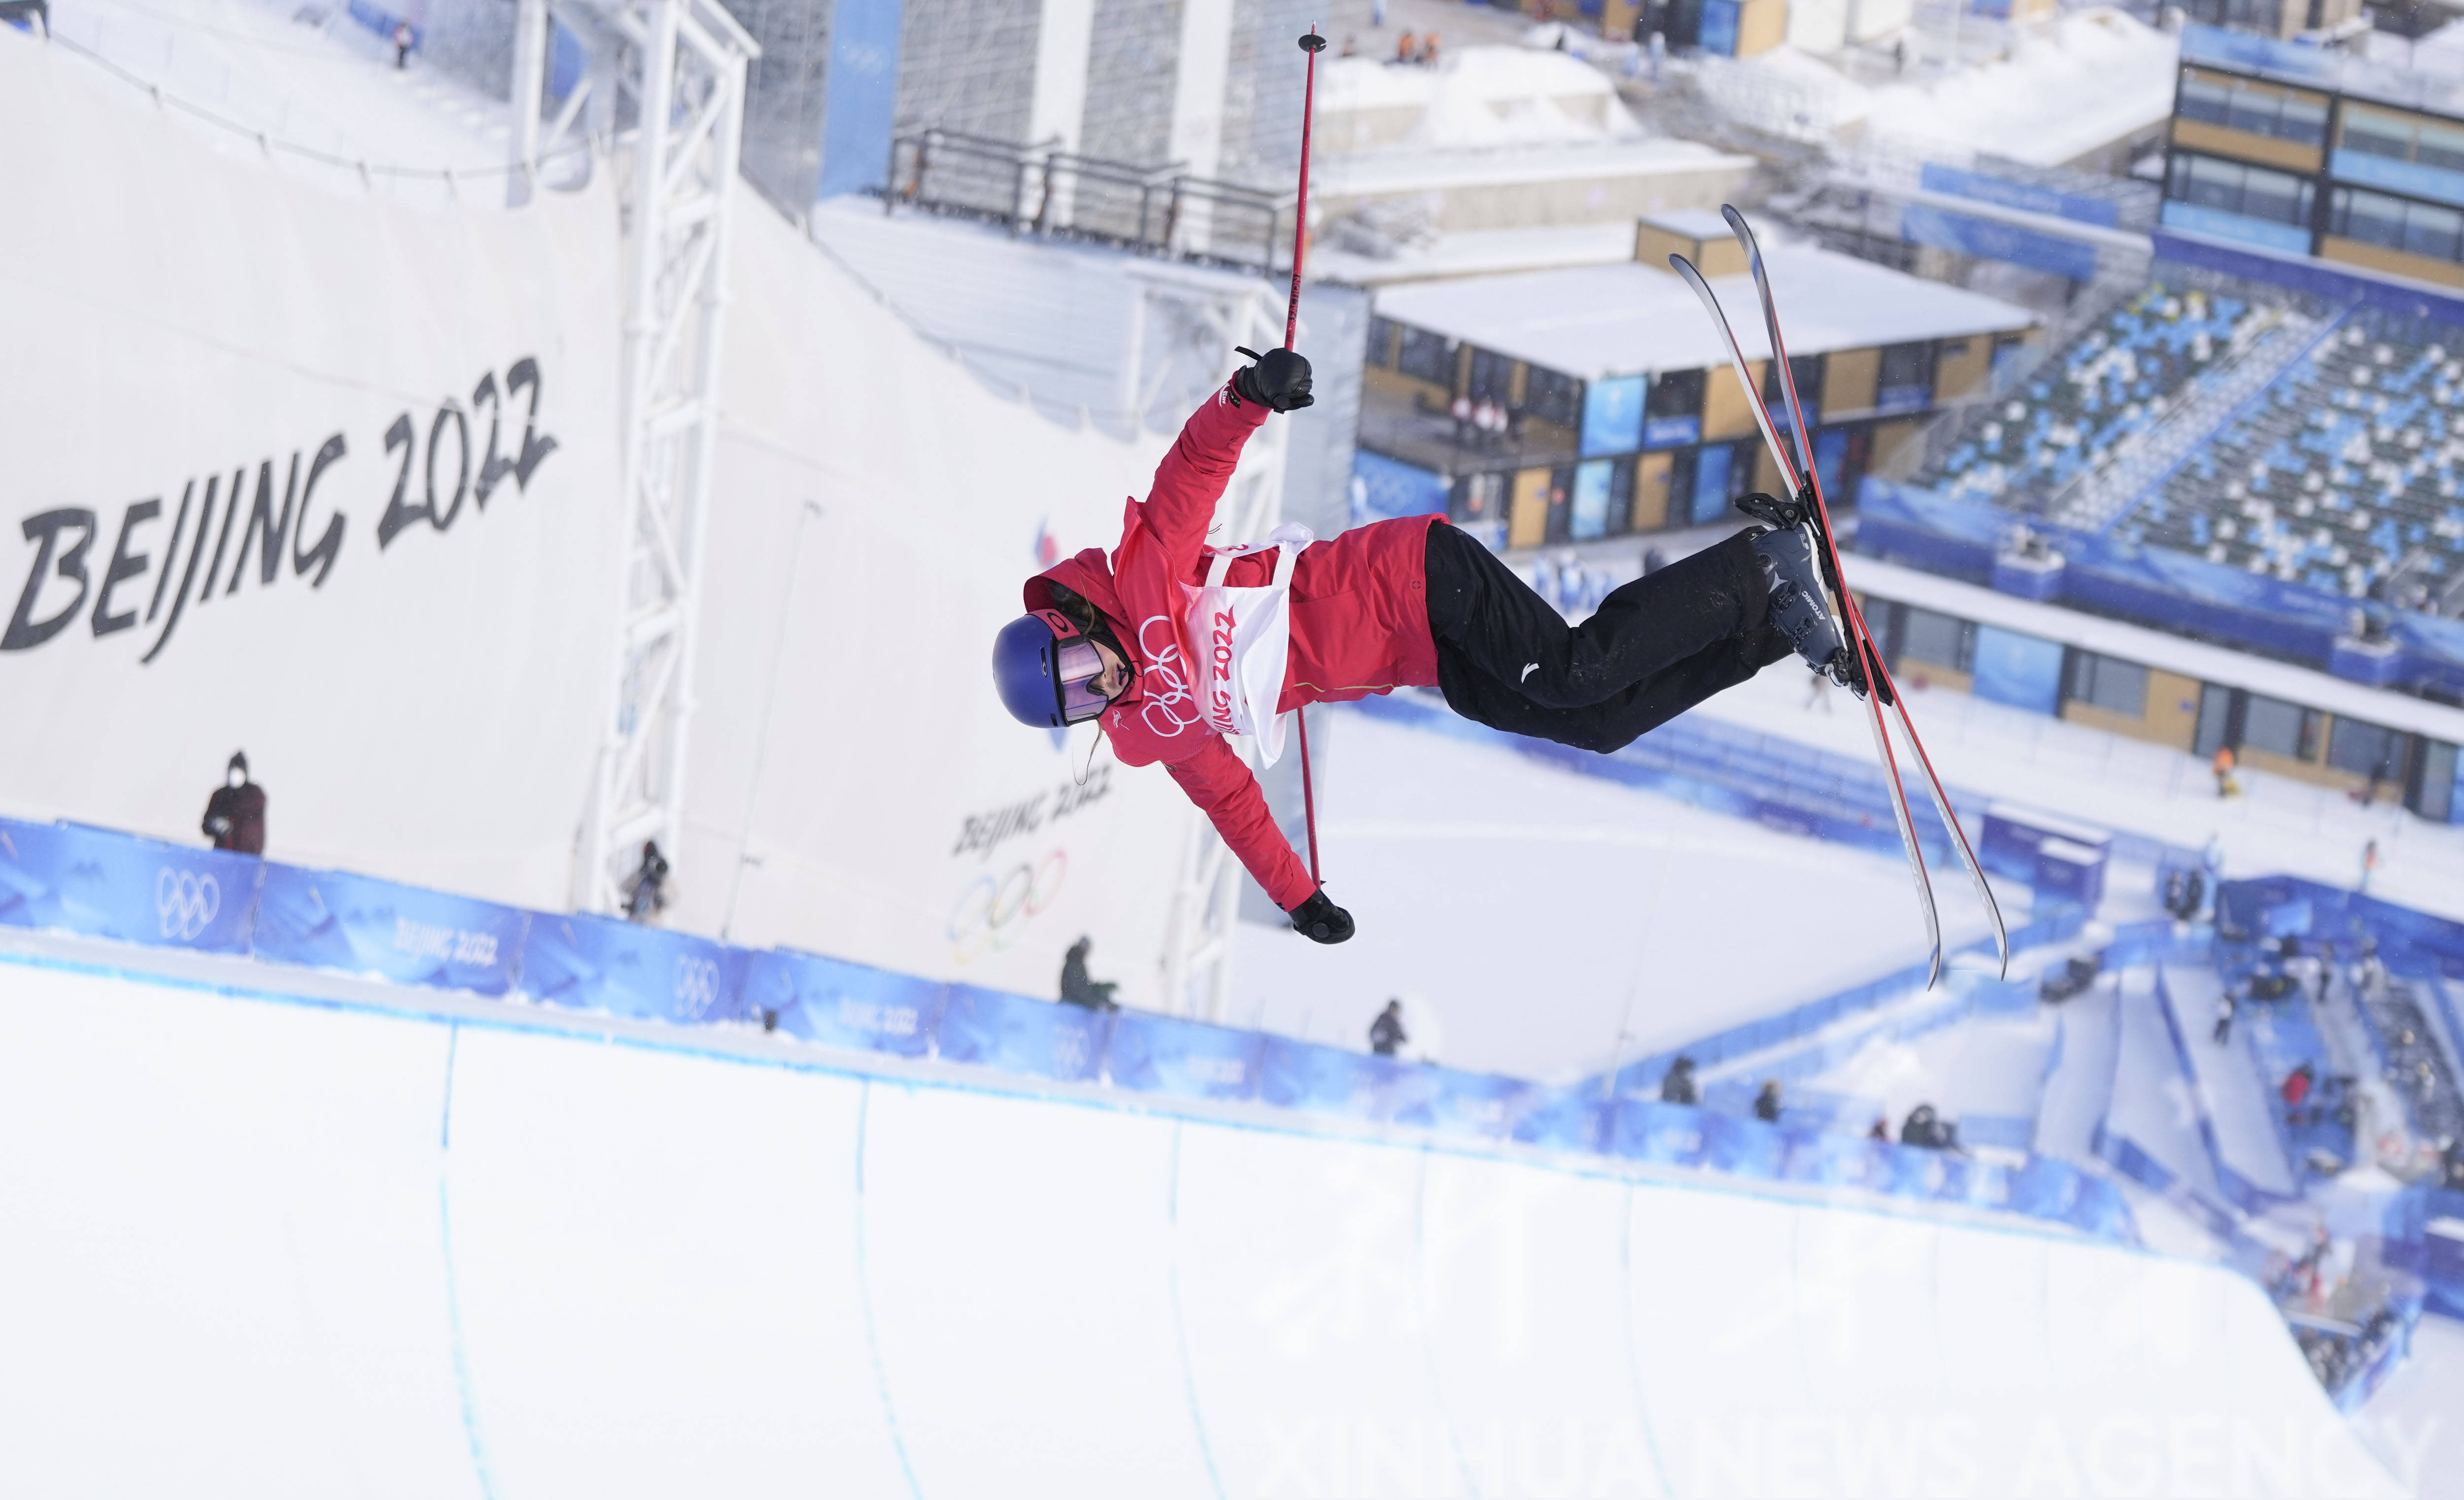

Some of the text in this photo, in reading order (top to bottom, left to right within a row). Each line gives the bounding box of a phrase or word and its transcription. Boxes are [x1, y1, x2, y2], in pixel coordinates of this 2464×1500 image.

[0, 355, 559, 664] BEIJING 2022
[1213, 605, 1236, 681] 2022
[1802, 591, 1826, 620] ATOMIC
[951, 763, 1111, 864] BEIJING 2022
[1893, 800, 1920, 887] FACTION
[394, 918, 499, 967] BEIJING 2022
